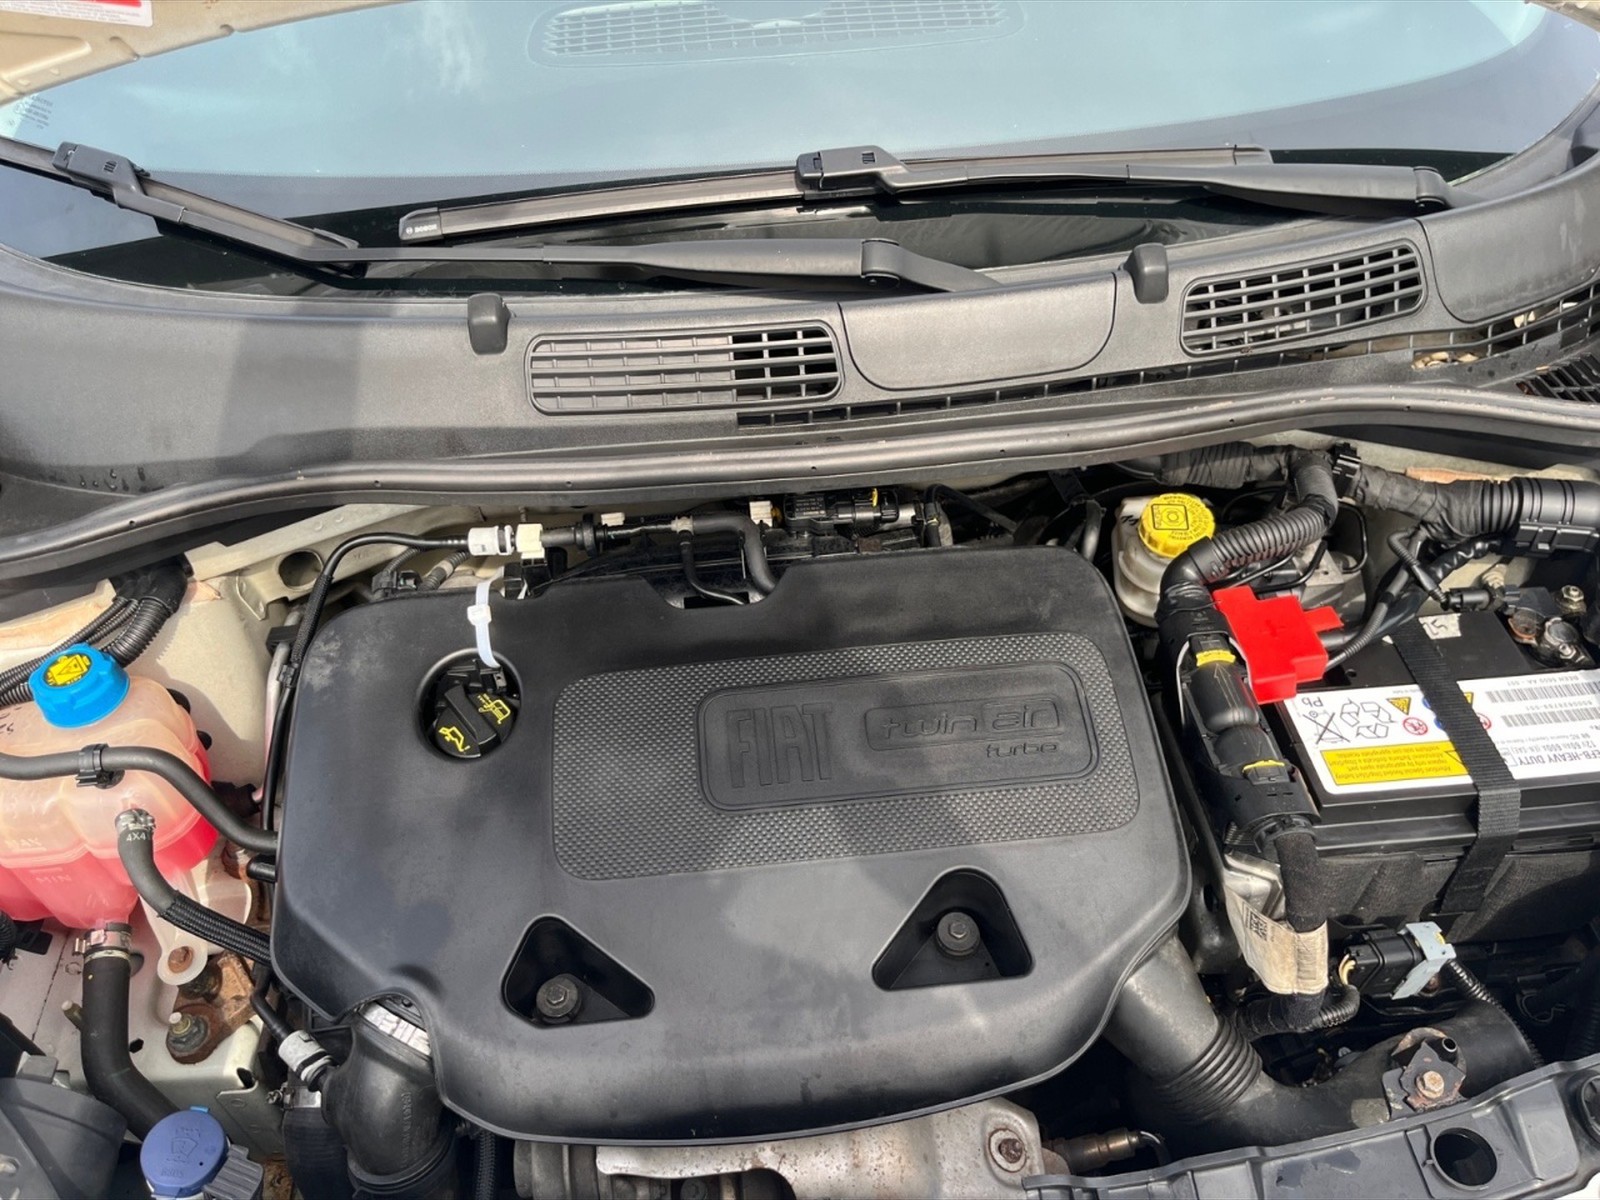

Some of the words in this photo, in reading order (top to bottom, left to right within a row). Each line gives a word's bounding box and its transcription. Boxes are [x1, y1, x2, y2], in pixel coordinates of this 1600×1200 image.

[1302, 697, 1323, 707] Pb
[881, 711, 977, 739] twin
[992, 706, 1048, 731] air
[726, 703, 834, 788] FIAT
[986, 742, 1058, 759] turbo
[1520, 755, 1546, 765] DUTY
[35, 874, 72, 883] MIN
